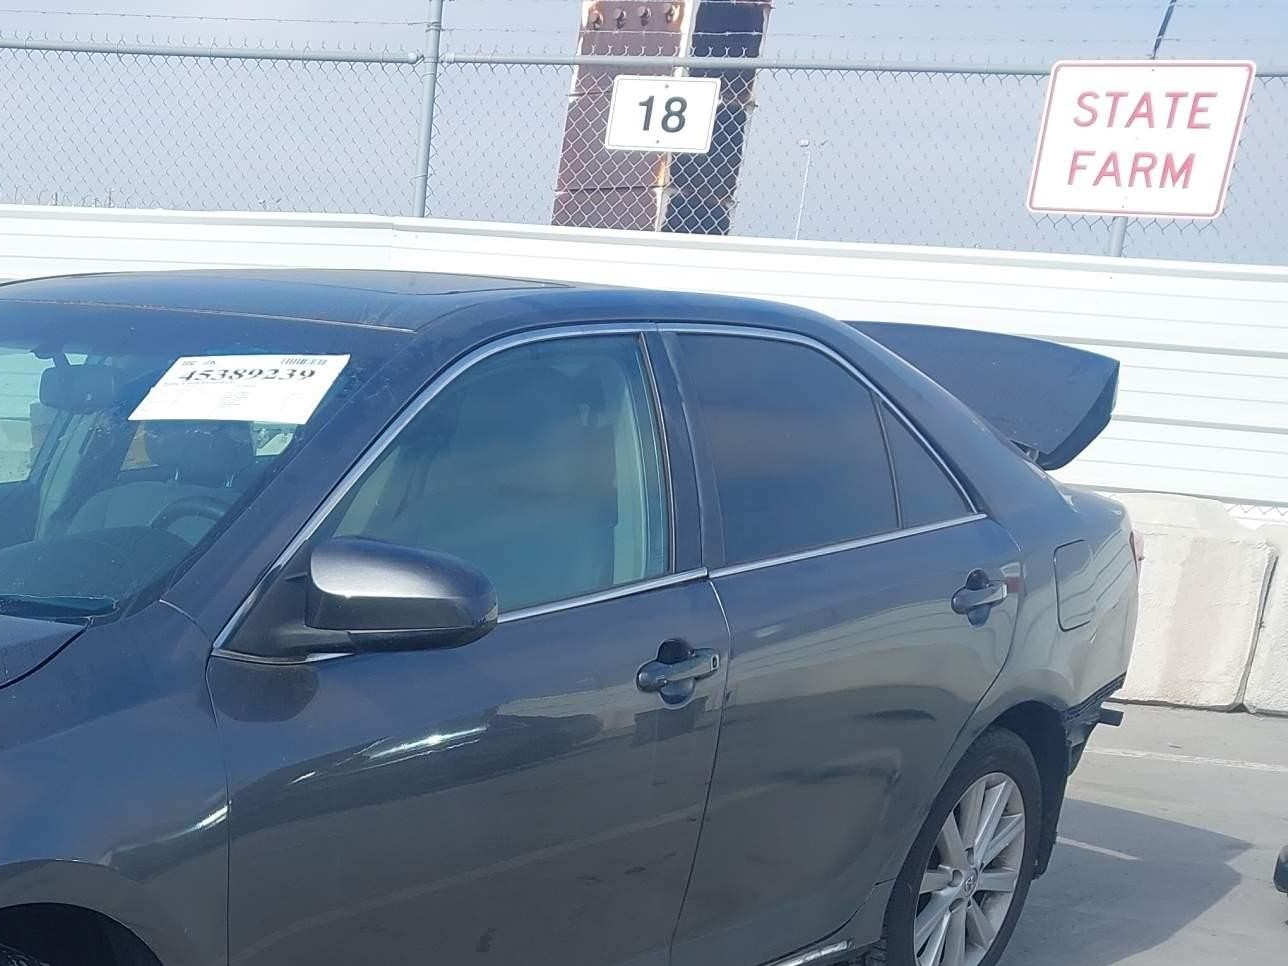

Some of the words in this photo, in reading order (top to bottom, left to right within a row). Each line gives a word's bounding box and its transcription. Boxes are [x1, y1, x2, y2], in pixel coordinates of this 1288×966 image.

[638, 95, 688, 133] 18
[1073, 91, 1218, 129] STATE
[1067, 151, 1196, 189] FARM
[178, 367, 317, 382] 45389239
